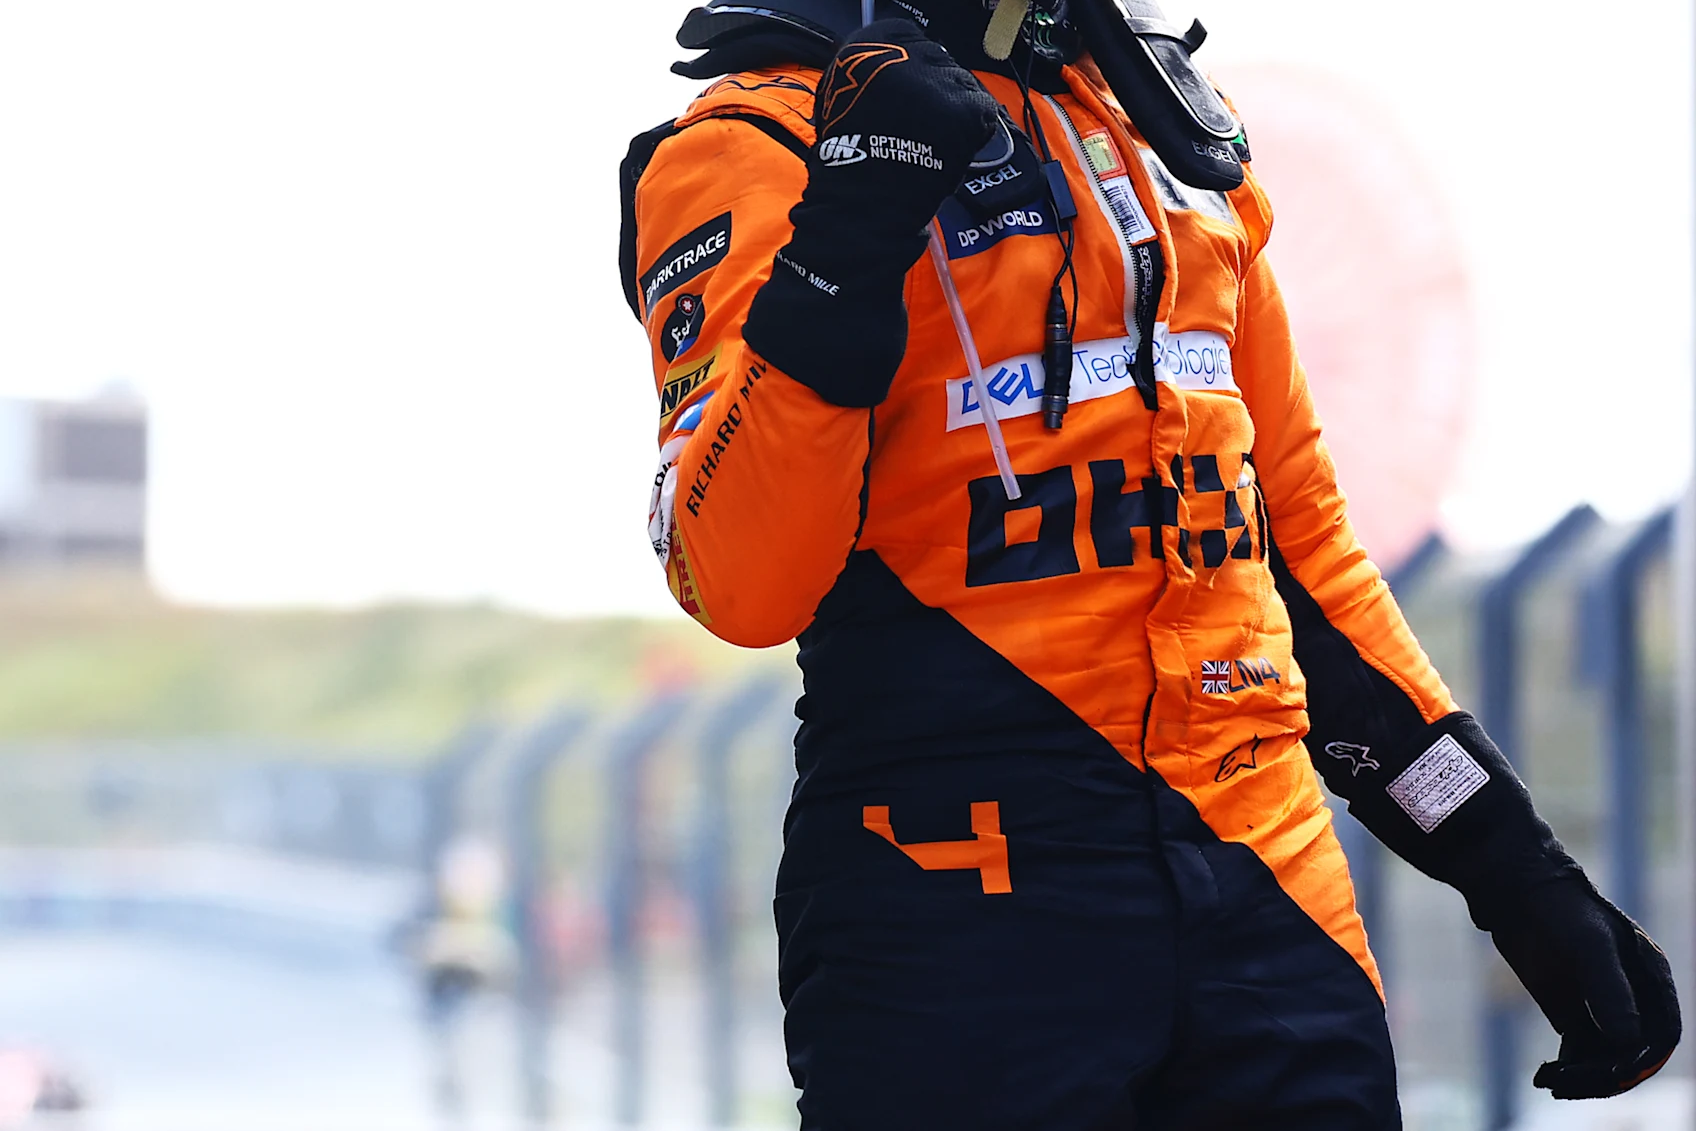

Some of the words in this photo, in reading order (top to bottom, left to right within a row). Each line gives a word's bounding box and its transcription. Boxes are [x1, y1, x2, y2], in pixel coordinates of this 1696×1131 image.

[869, 135, 932, 157] OPTIMUM
[870, 147, 943, 170] NUTRITION
[1191, 140, 1238, 164] EXGEL
[964, 164, 1022, 194] EXGEL
[957, 229, 980, 248] DP
[979, 210, 1043, 236] WORLD
[808, 272, 840, 296] MILLE
[962, 357, 1046, 415] DEL
[1072, 339, 1229, 385] Tecologie
[686, 402, 742, 518] RICHARD
[740, 360, 767, 402] MIL
[1229, 658, 1280, 692] LN4
[862, 801, 1013, 895] 4
